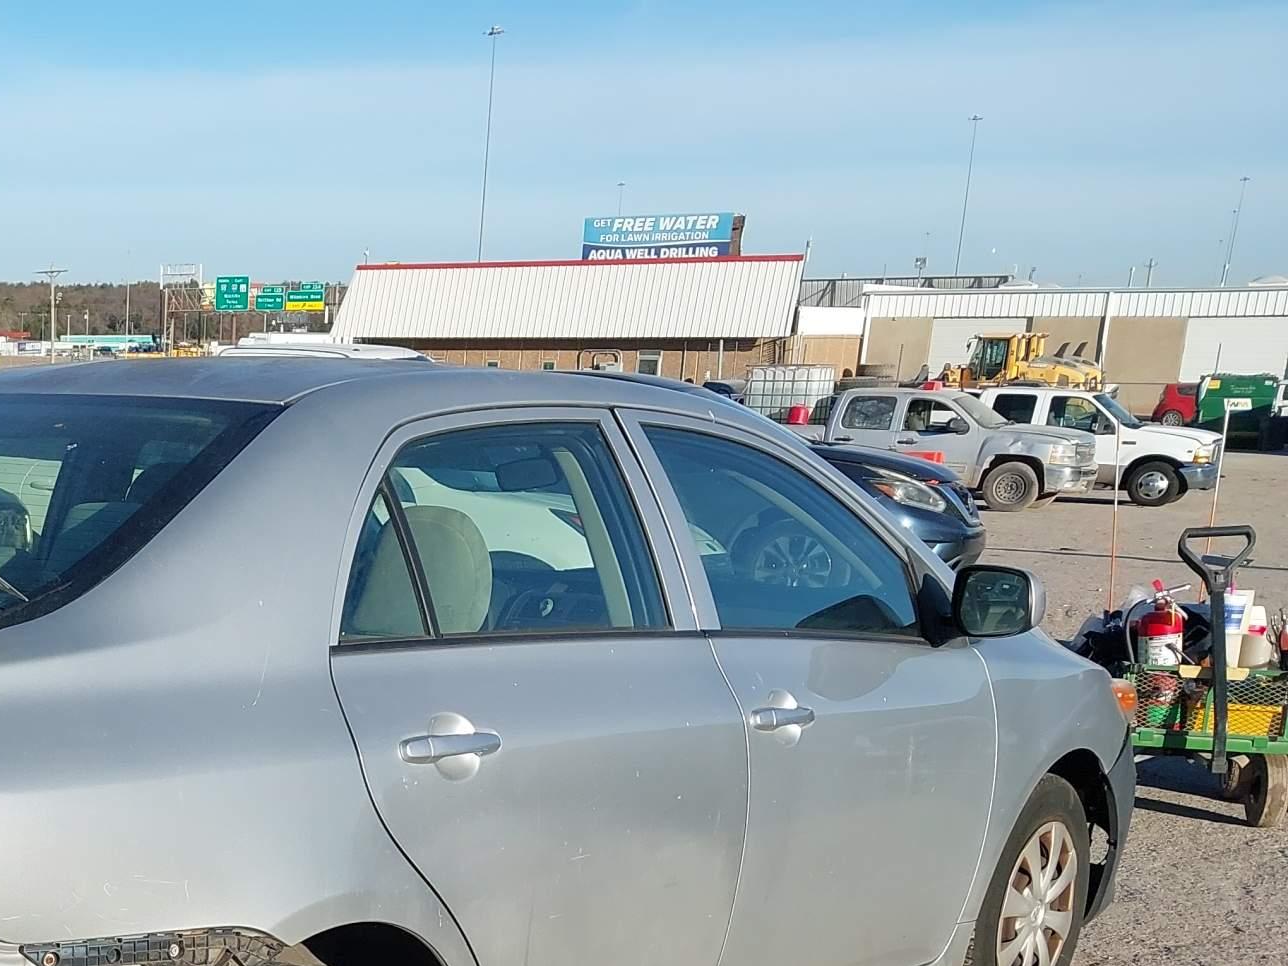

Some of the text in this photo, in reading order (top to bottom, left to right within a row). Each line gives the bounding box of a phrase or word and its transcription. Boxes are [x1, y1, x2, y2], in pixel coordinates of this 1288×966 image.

[594, 216, 719, 231] GET FREE WATER
[600, 231, 708, 242] FOR LAWN IRRIGATION
[588, 246, 718, 260] AQUA WELL DRILLING
